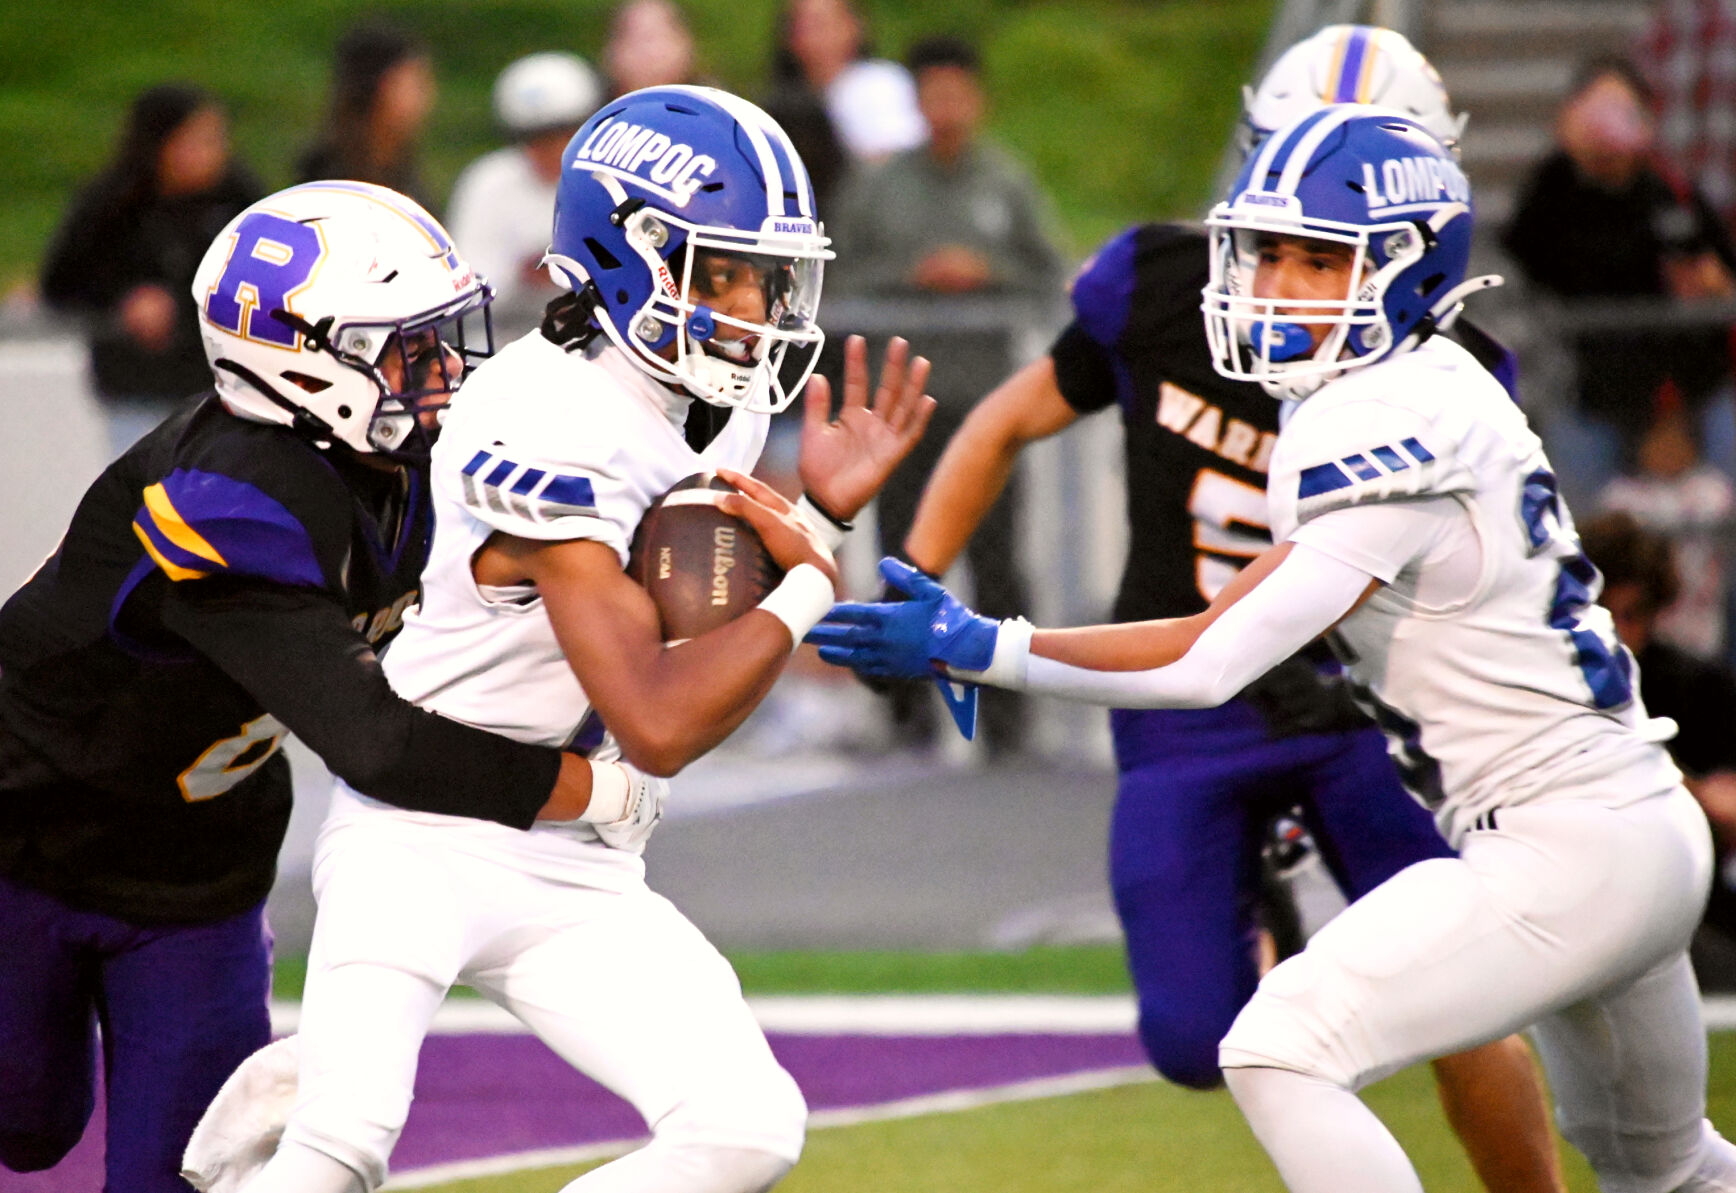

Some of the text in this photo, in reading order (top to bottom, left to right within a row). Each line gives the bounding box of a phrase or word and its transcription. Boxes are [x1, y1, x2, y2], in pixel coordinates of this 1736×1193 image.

[577, 117, 716, 196] LOMPOC
[1362, 156, 1469, 208] LOMPO
[774, 222, 812, 234] BRAVES
[204, 209, 329, 352] R
[658, 266, 681, 301] Ridd
[659, 546, 672, 580] NCAA
[711, 526, 737, 606] Wilson
